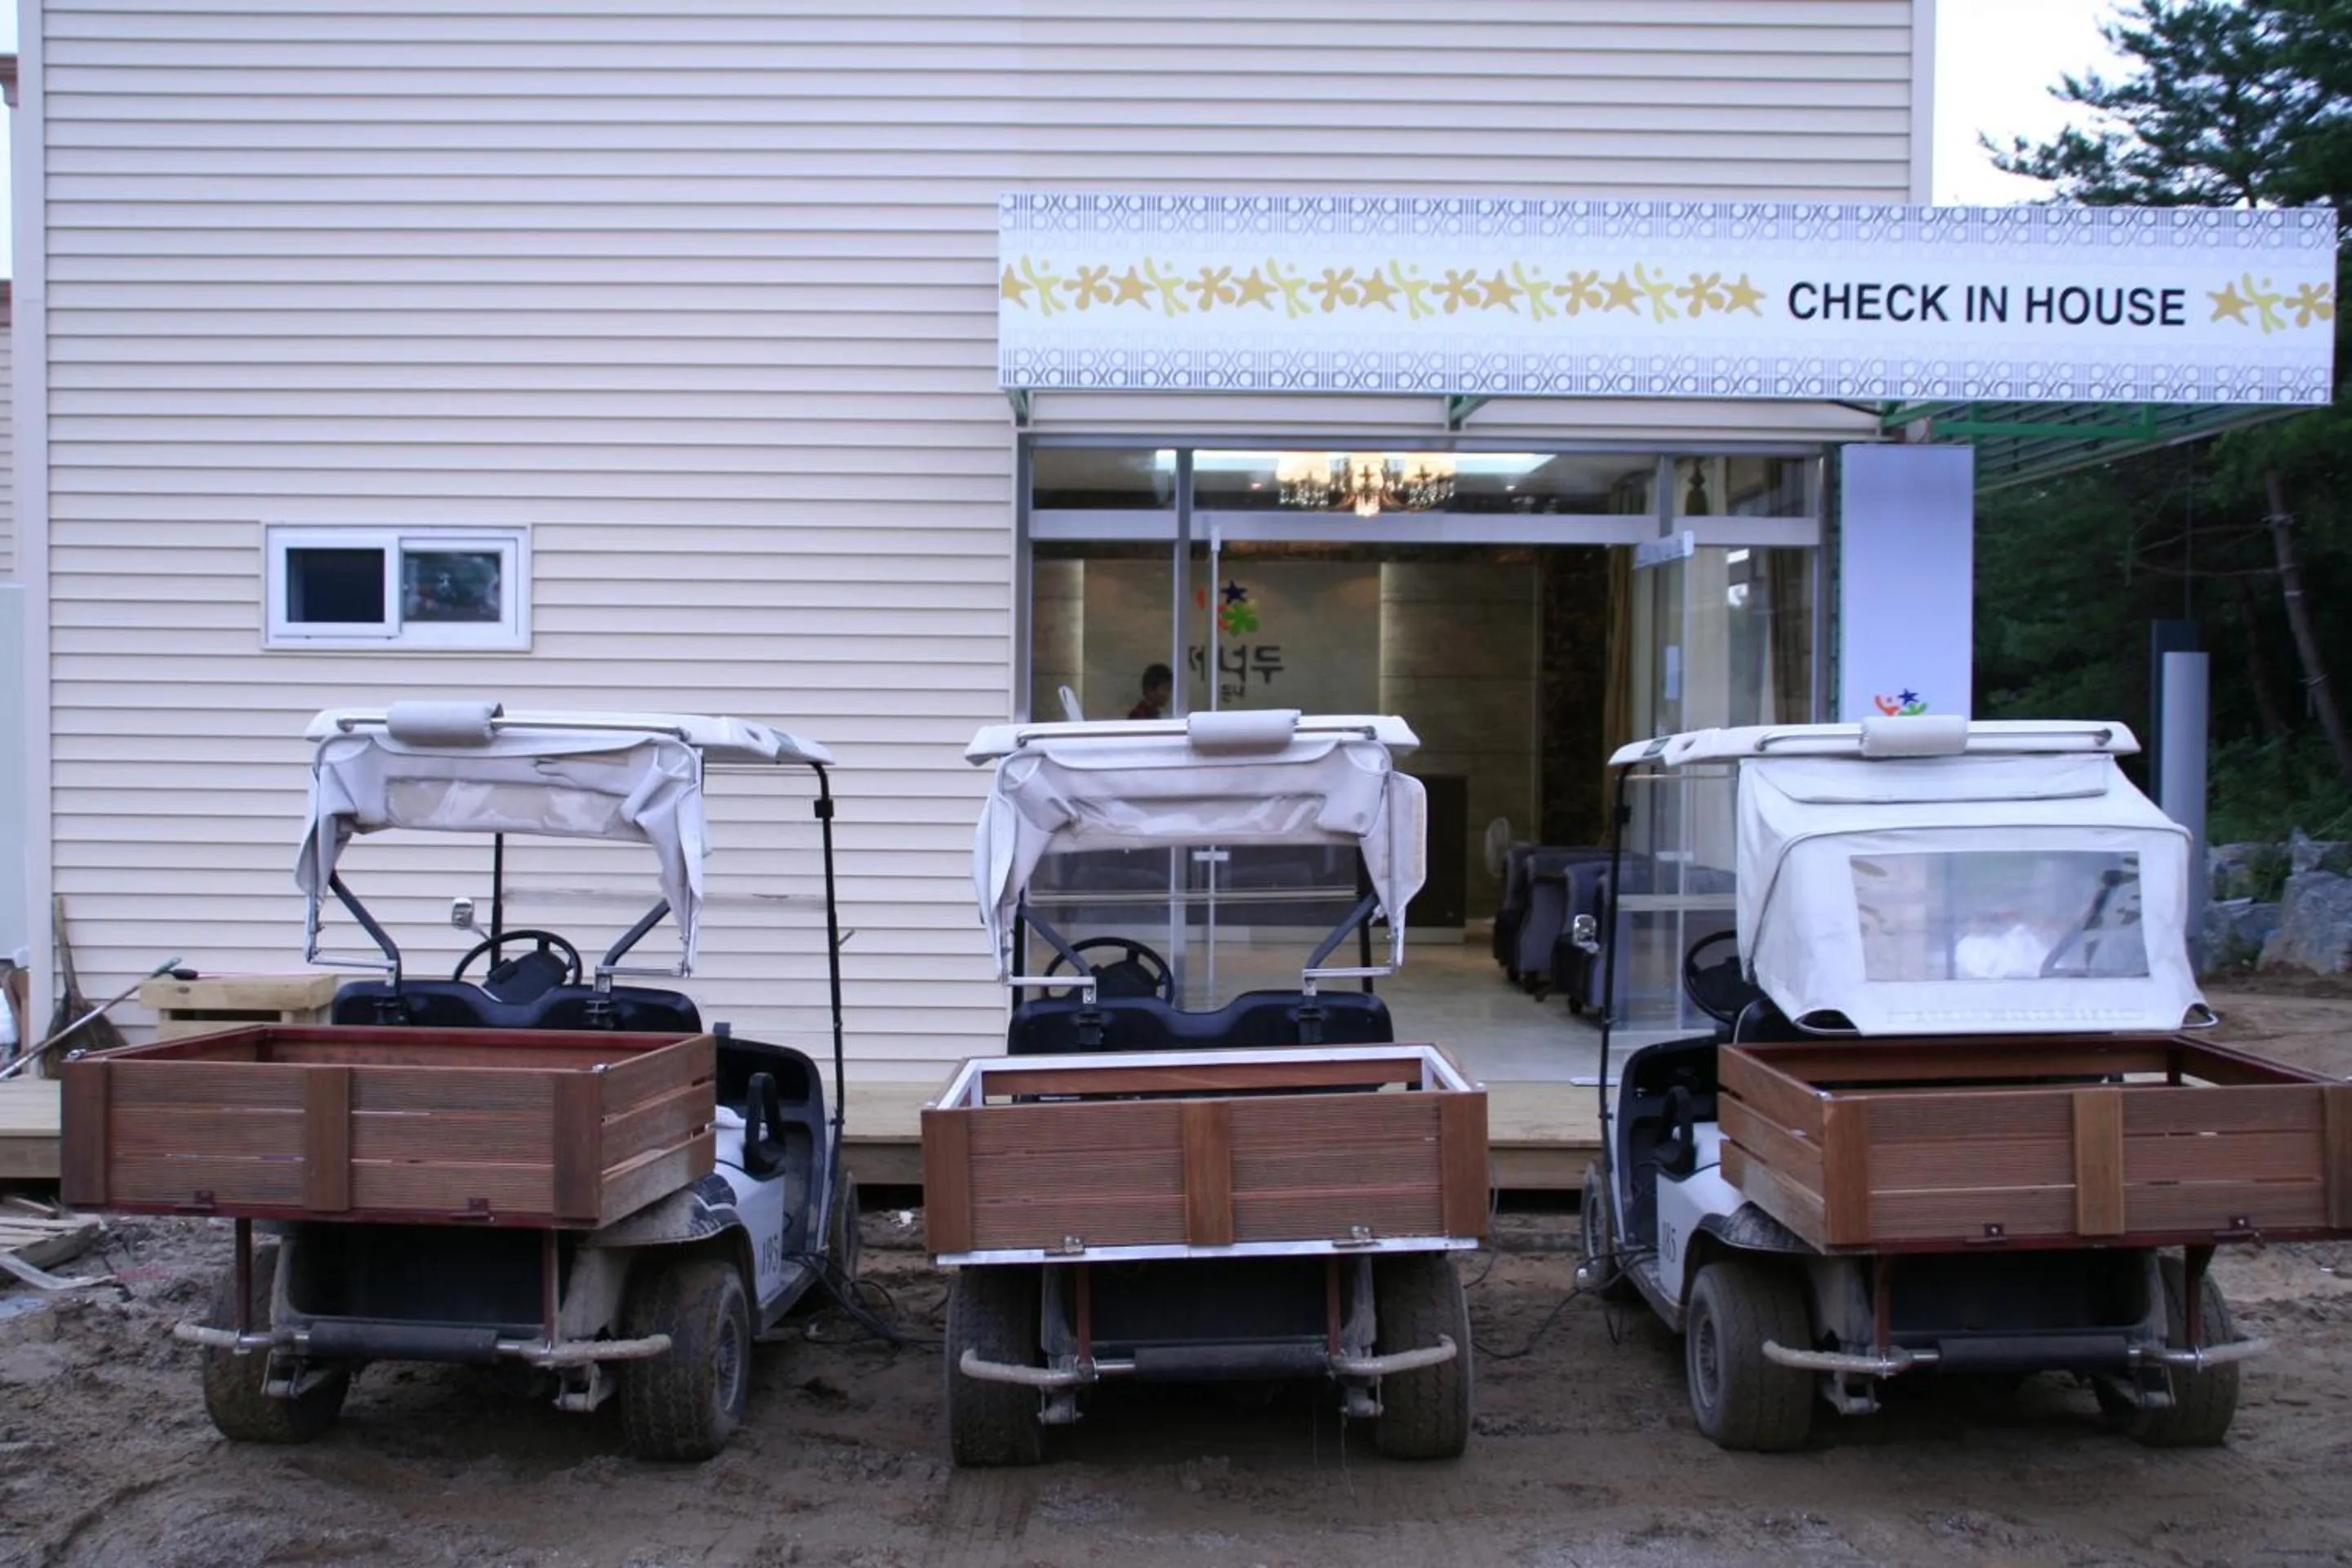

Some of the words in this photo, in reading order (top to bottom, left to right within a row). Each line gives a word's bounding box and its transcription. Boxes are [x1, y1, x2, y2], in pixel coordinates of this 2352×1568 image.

[1788, 282, 1949, 322] CHECK
[1965, 286, 2008, 323] IN
[2026, 286, 2186, 326] HOUSE
